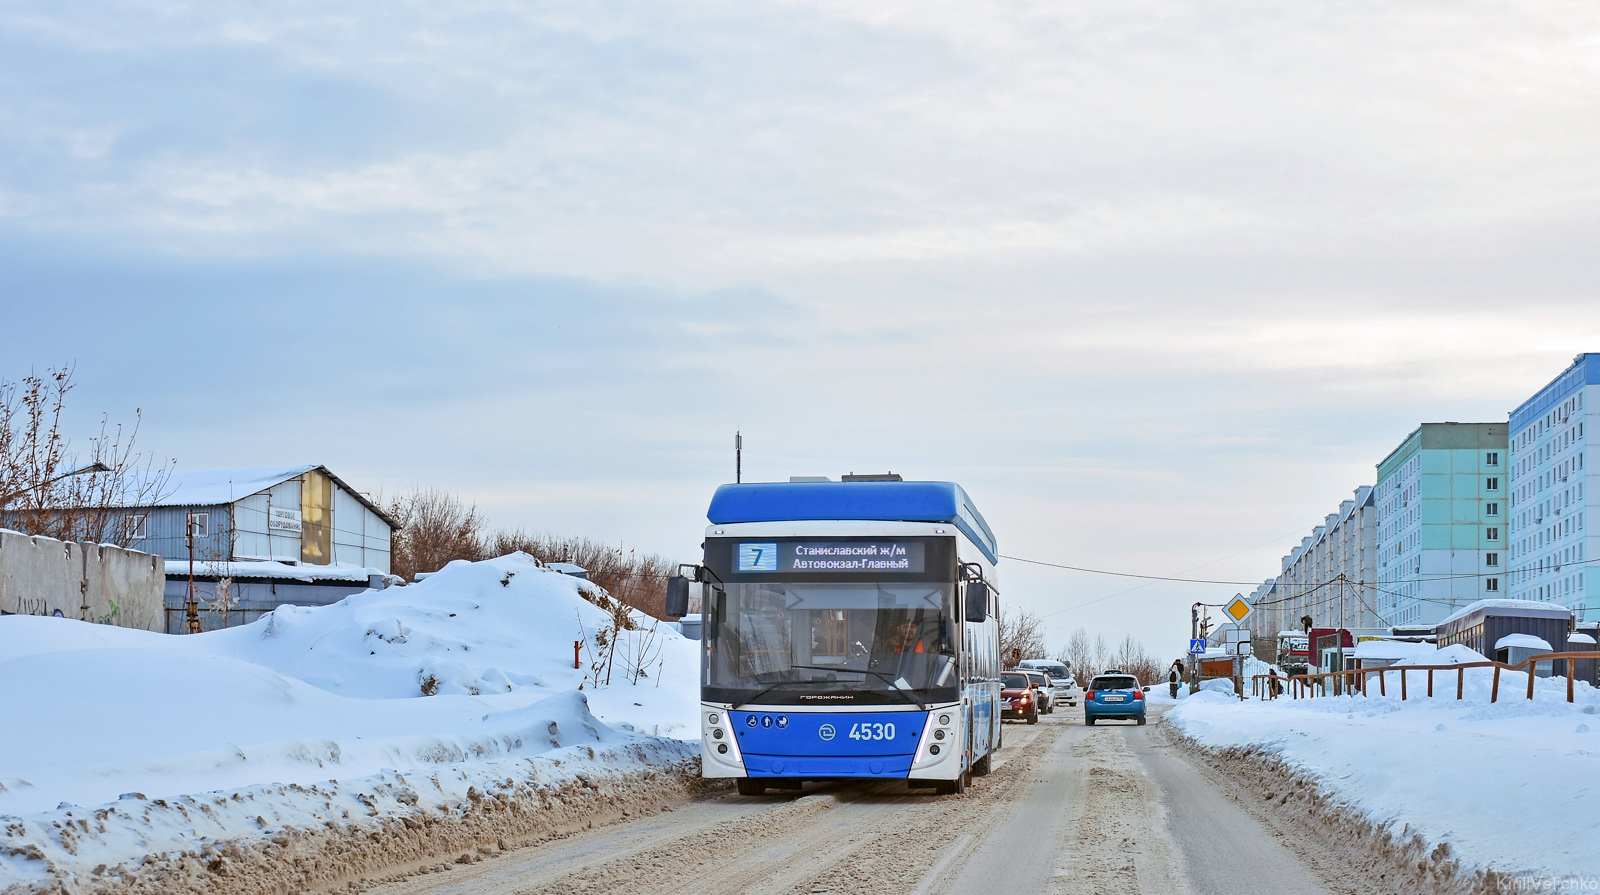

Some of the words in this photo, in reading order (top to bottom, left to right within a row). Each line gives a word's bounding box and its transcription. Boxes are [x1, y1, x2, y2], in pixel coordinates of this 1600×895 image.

[751, 548, 764, 566] 7
[795, 545, 877, 556] Станиславский
[879, 544, 906, 557] ж/м
[793, 558, 909, 569] Автовокзал-Главный
[848, 722, 896, 741] 4530
